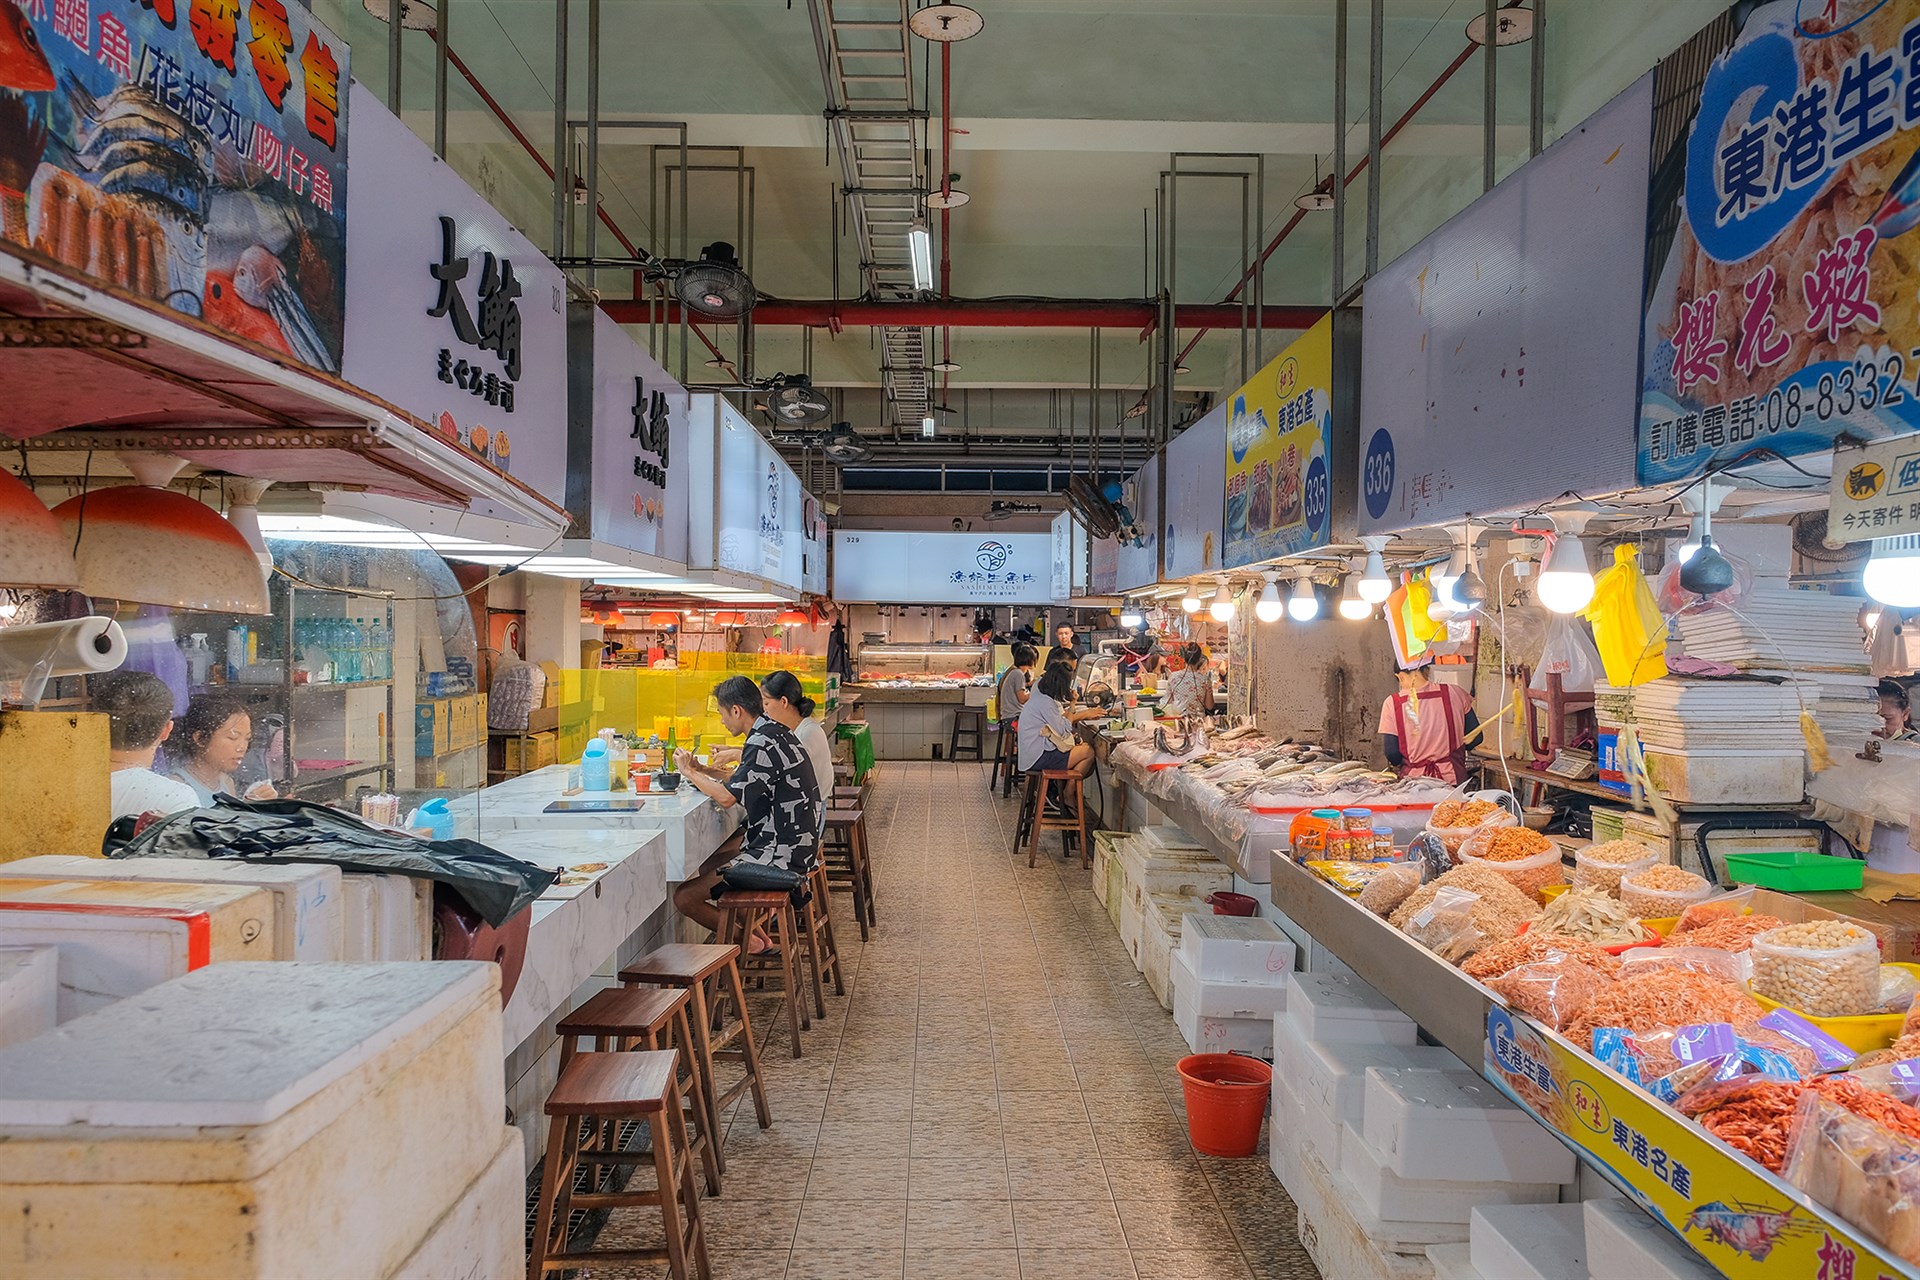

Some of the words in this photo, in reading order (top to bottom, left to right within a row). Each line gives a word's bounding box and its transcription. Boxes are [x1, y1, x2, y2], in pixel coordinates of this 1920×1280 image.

[427, 216, 521, 382] 大鮪
[1671, 226, 1880, 396] 櫻花蝦
[630, 376, 670, 469] 大鮪
[1277, 387, 1315, 438] 東港名產
[1650, 344, 1920, 463] 訂購電話:08-8332
[1306, 473, 1326, 517] 335
[1366, 450, 1392, 496] 336
[1842, 504, 1904, 531] 今天寄件
[1497, 1034, 1551, 1094] 東港生富
[1574, 1086, 1602, 1128] 和生
[1612, 1117, 1692, 1201] 東港名產
